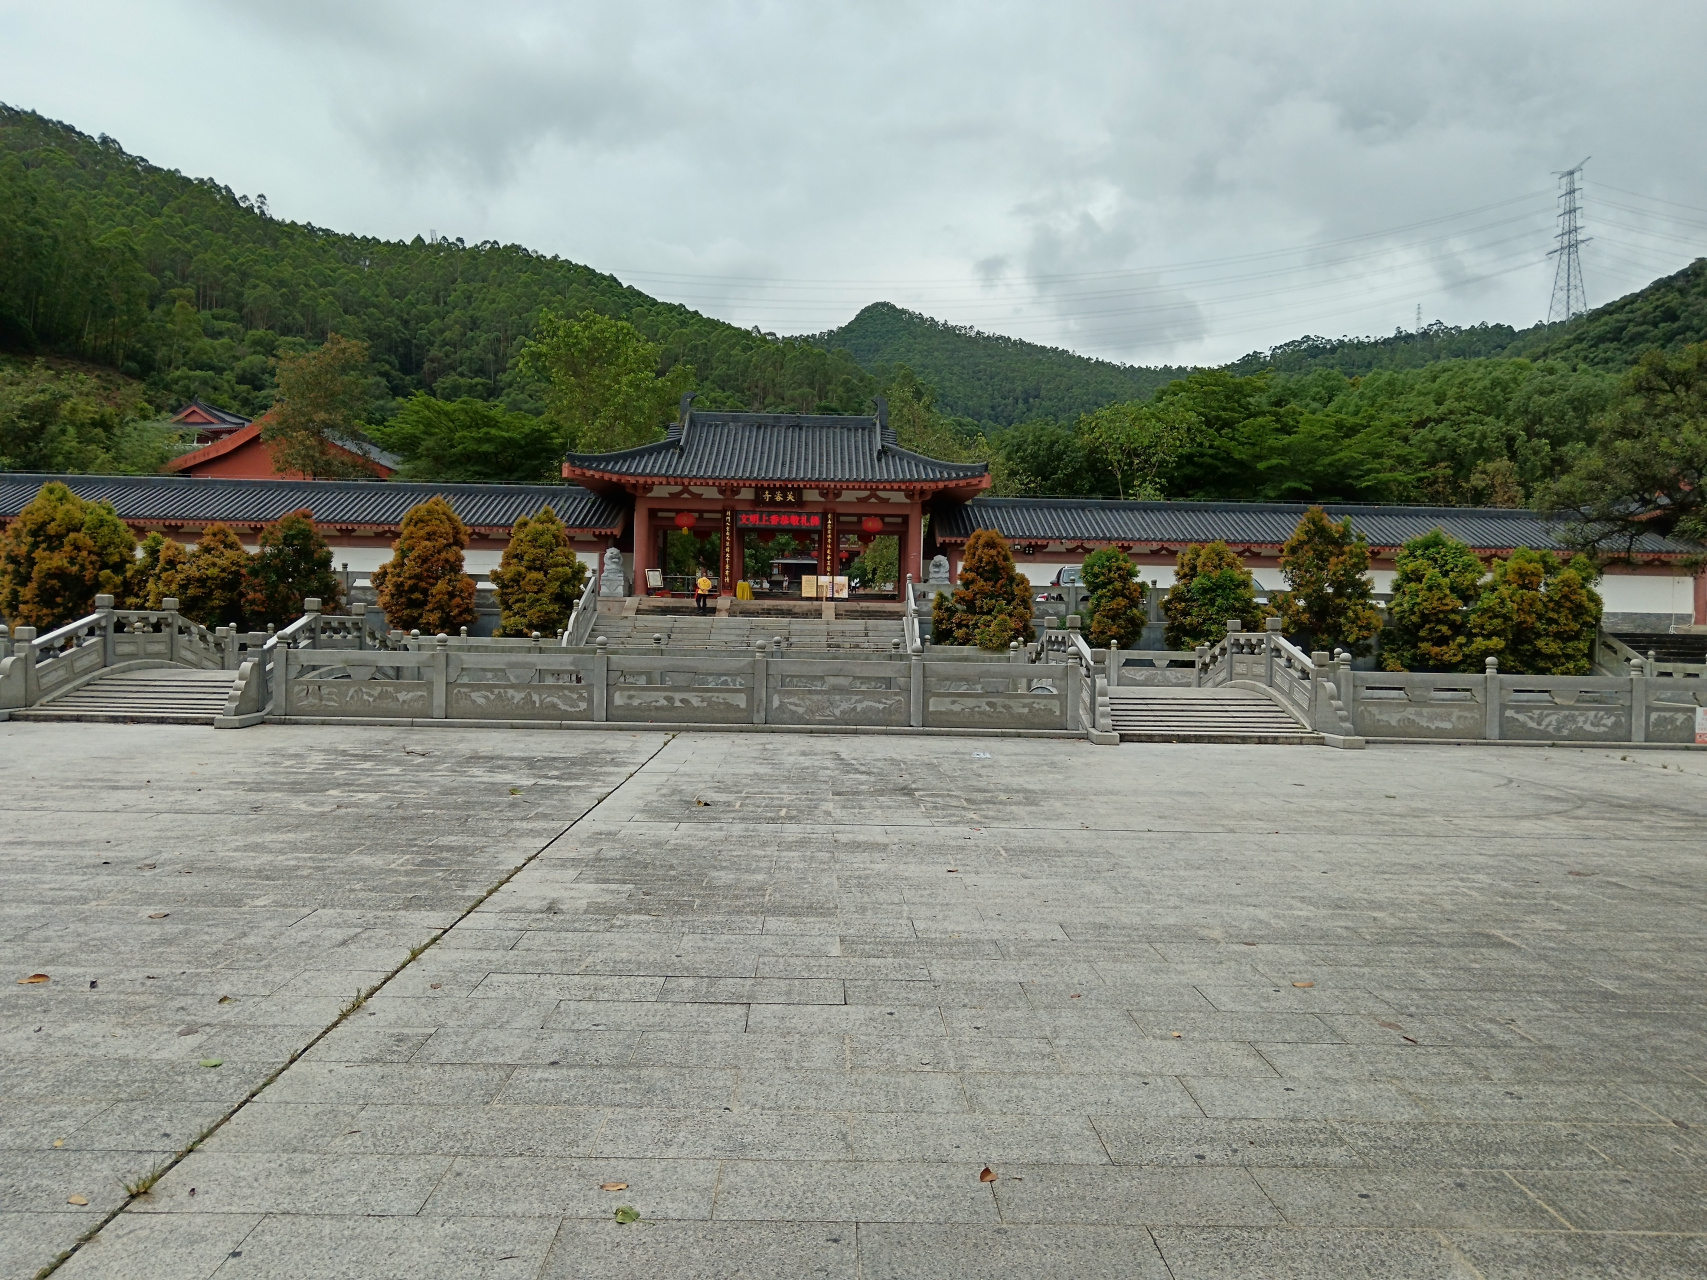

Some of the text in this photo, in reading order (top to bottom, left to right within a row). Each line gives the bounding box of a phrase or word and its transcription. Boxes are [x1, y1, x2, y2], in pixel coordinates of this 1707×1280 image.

[739, 513, 820, 526] 文明上香恭敬礼佛
